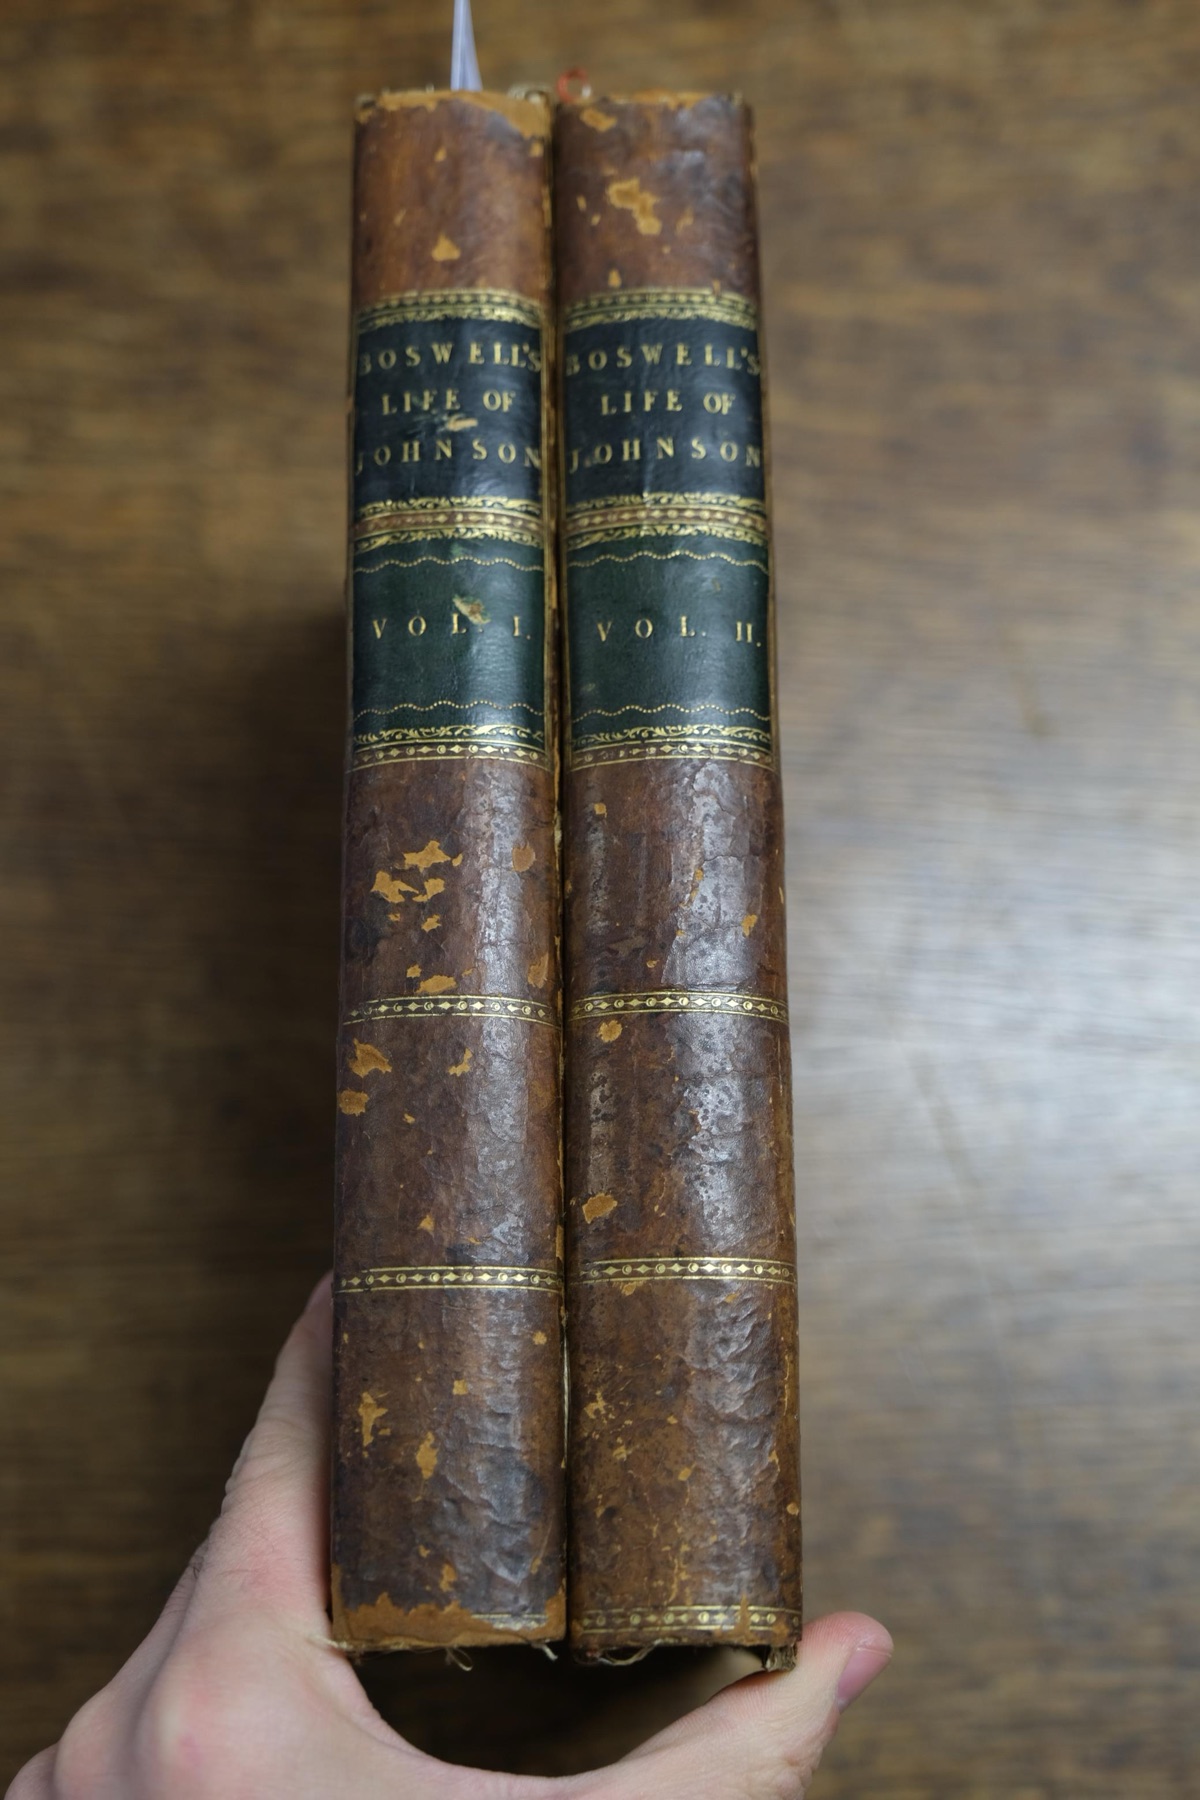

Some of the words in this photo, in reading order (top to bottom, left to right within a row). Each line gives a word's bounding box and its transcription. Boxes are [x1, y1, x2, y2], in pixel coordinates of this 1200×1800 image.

[565, 342, 761, 376] BOSWELL'S
[382, 389, 461, 415] LIFE
[483, 389, 516, 413] OF
[601, 389, 683, 416] LIFE
[703, 391, 736, 415] OF
[355, 437, 542, 476] JOHNSON
[569, 436, 761, 474] JOHNSON
[372, 612, 484, 640] VOL.
[513, 615, 532, 641] I.
[597, 615, 707, 642] VOL.
[736, 621, 762, 648] II.
